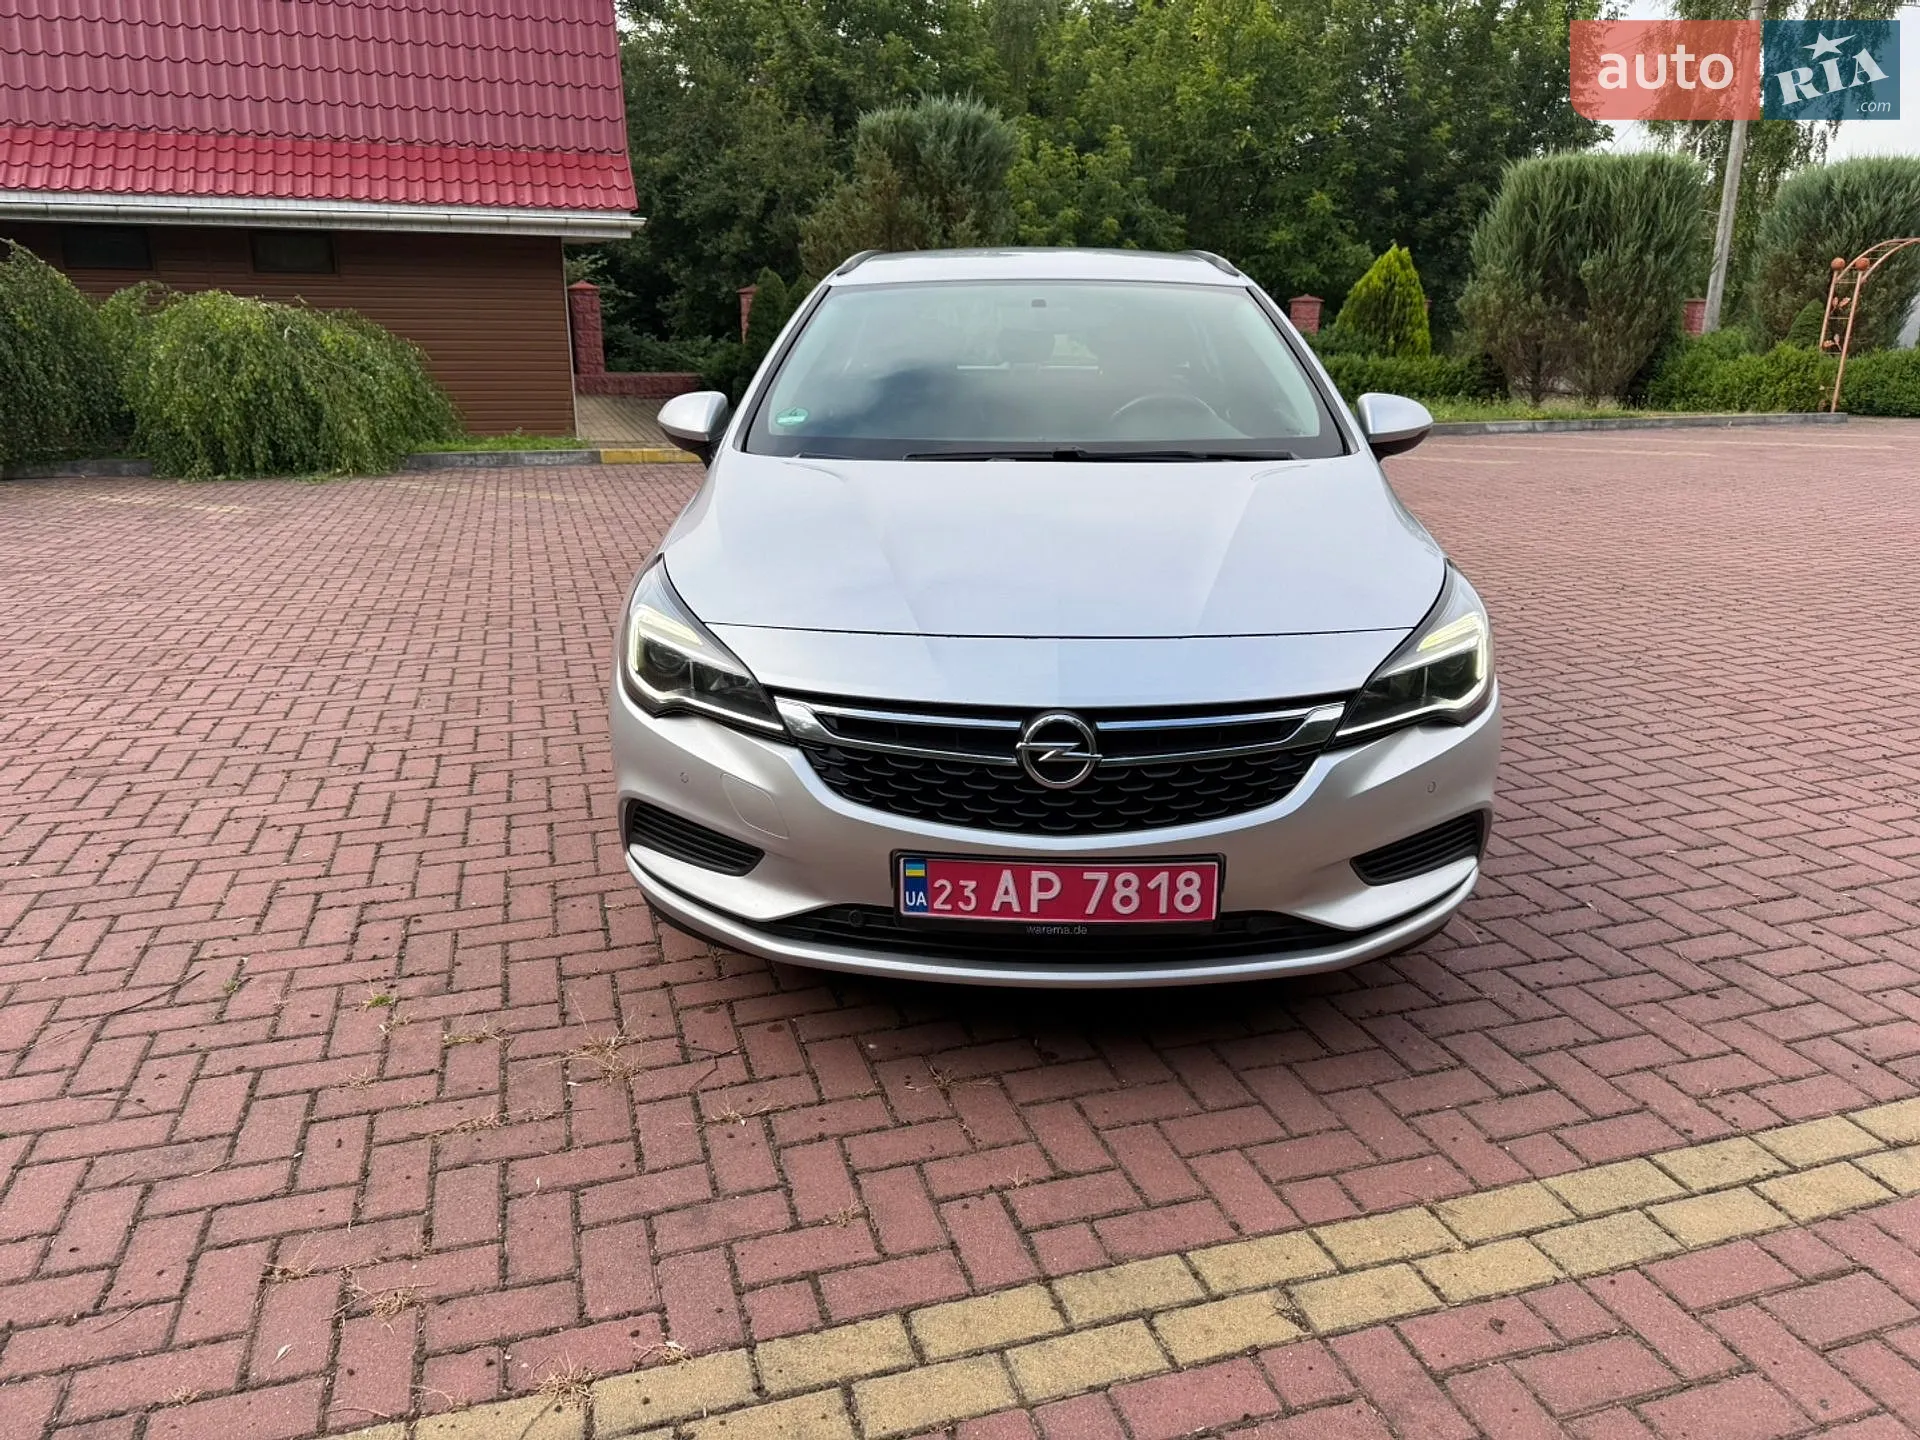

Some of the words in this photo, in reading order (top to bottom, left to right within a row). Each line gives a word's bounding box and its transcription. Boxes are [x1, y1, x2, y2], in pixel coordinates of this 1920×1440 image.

[905, 891, 927, 907] UA
[932, 879, 978, 912] 23
[991, 869, 1062, 913] AP
[1082, 870, 1202, 915] 7818
